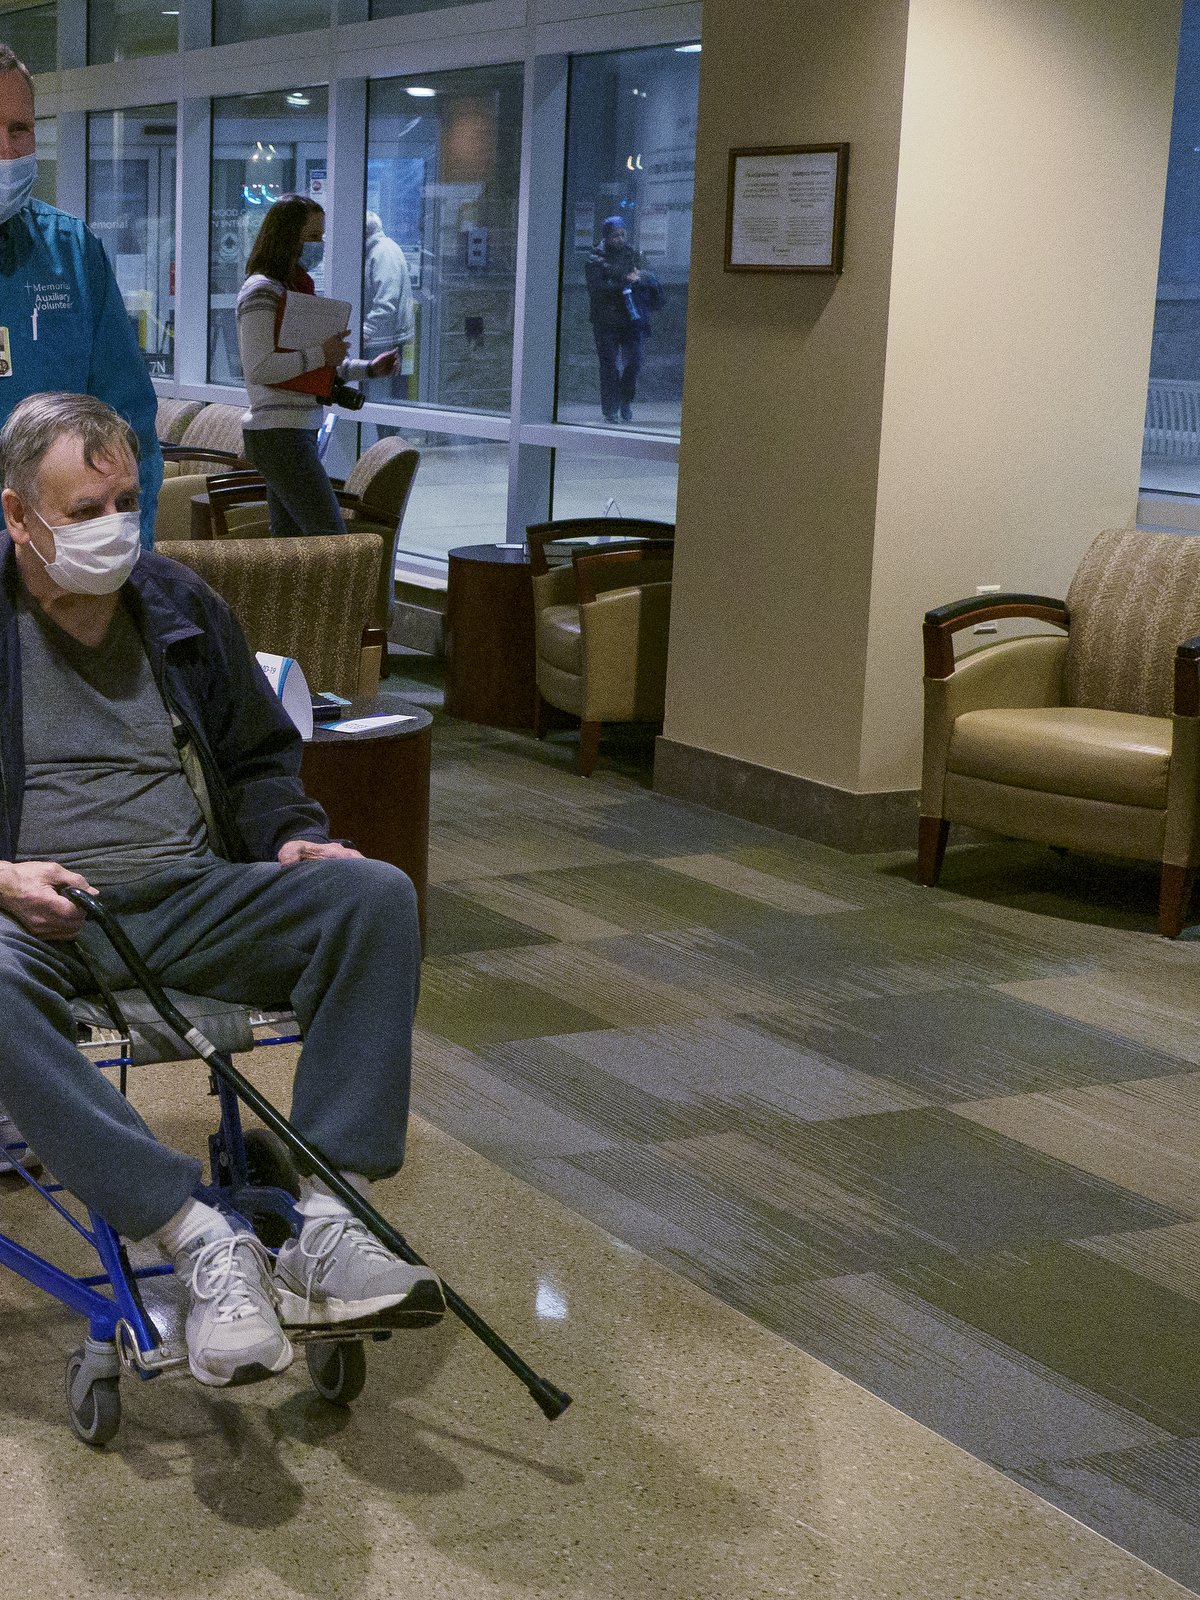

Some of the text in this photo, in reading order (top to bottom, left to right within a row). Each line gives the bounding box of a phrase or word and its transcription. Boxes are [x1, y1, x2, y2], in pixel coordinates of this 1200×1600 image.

[90, 219, 129, 230] emorial
[35, 292, 71, 303] Auxiliary
[34, 301, 75, 311] Volunteer
